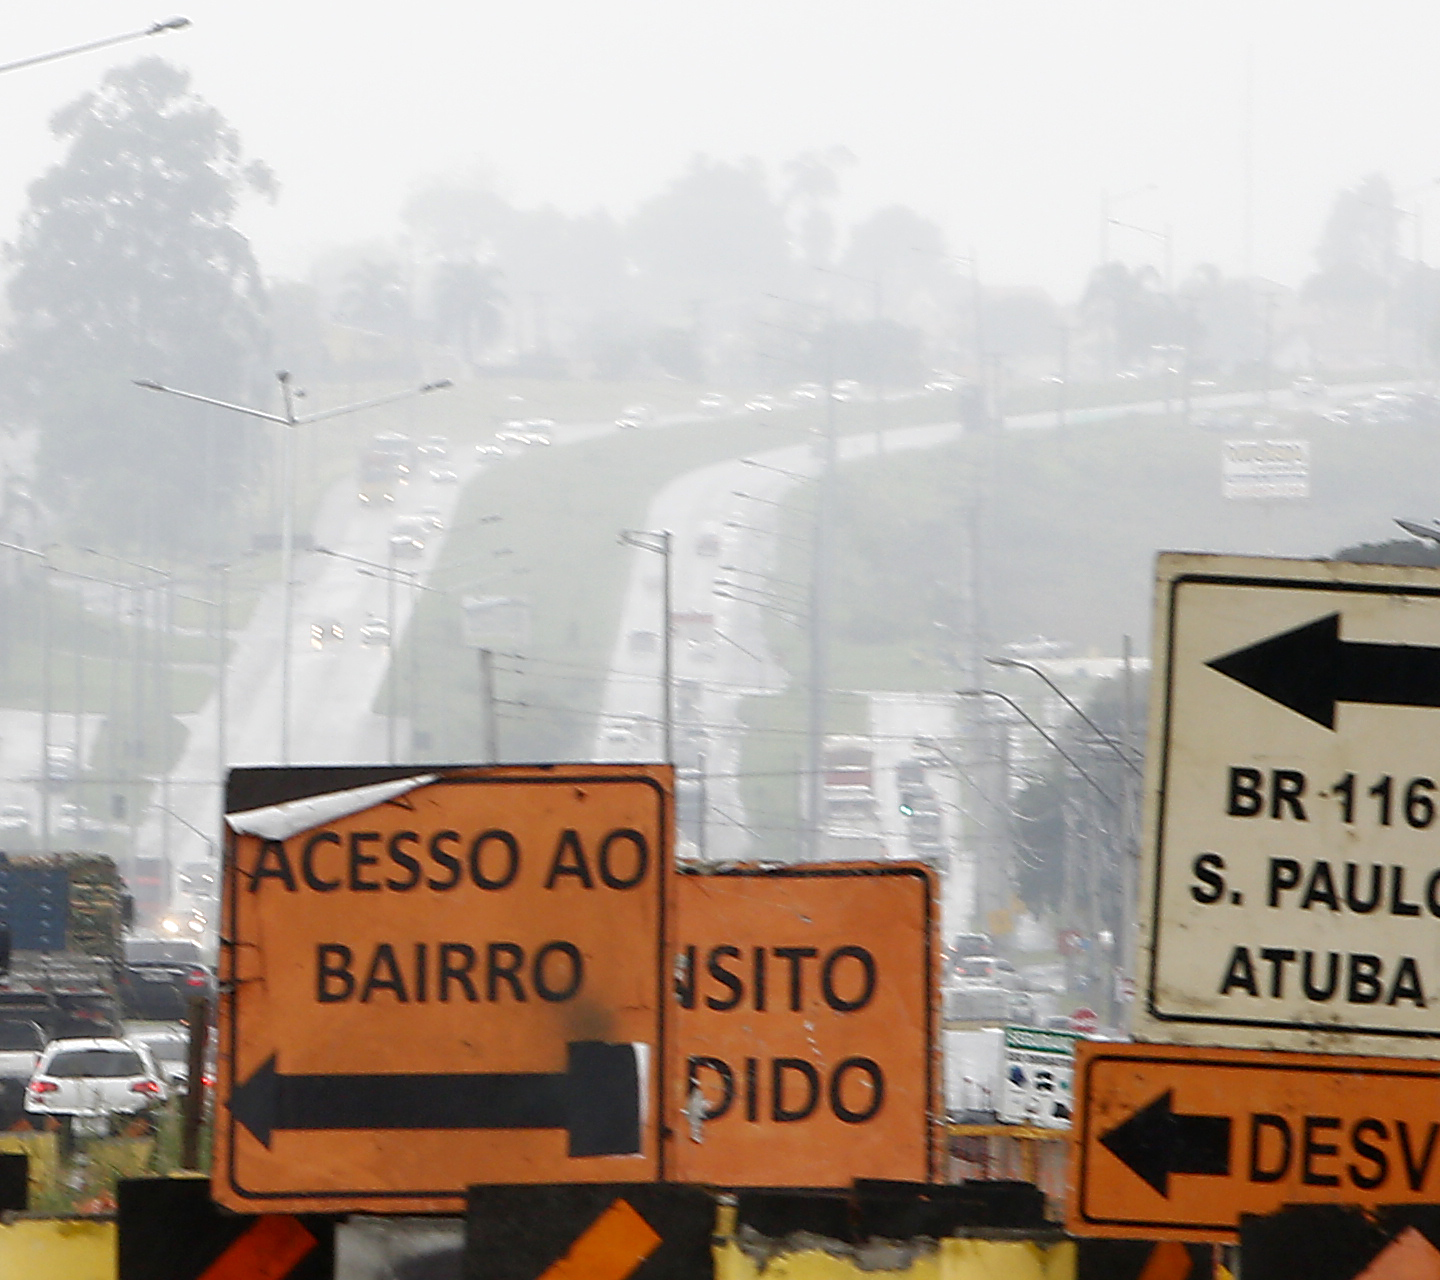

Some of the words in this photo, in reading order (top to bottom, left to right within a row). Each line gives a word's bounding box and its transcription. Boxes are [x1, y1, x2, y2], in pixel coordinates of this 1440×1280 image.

[247, 830, 521, 894] ACESSO
[543, 829, 651, 892] AO
[1189, 853, 1244, 907] S.
[316, 941, 586, 1005] BAIRRO
[1218, 946, 1428, 1010] ATUBA
